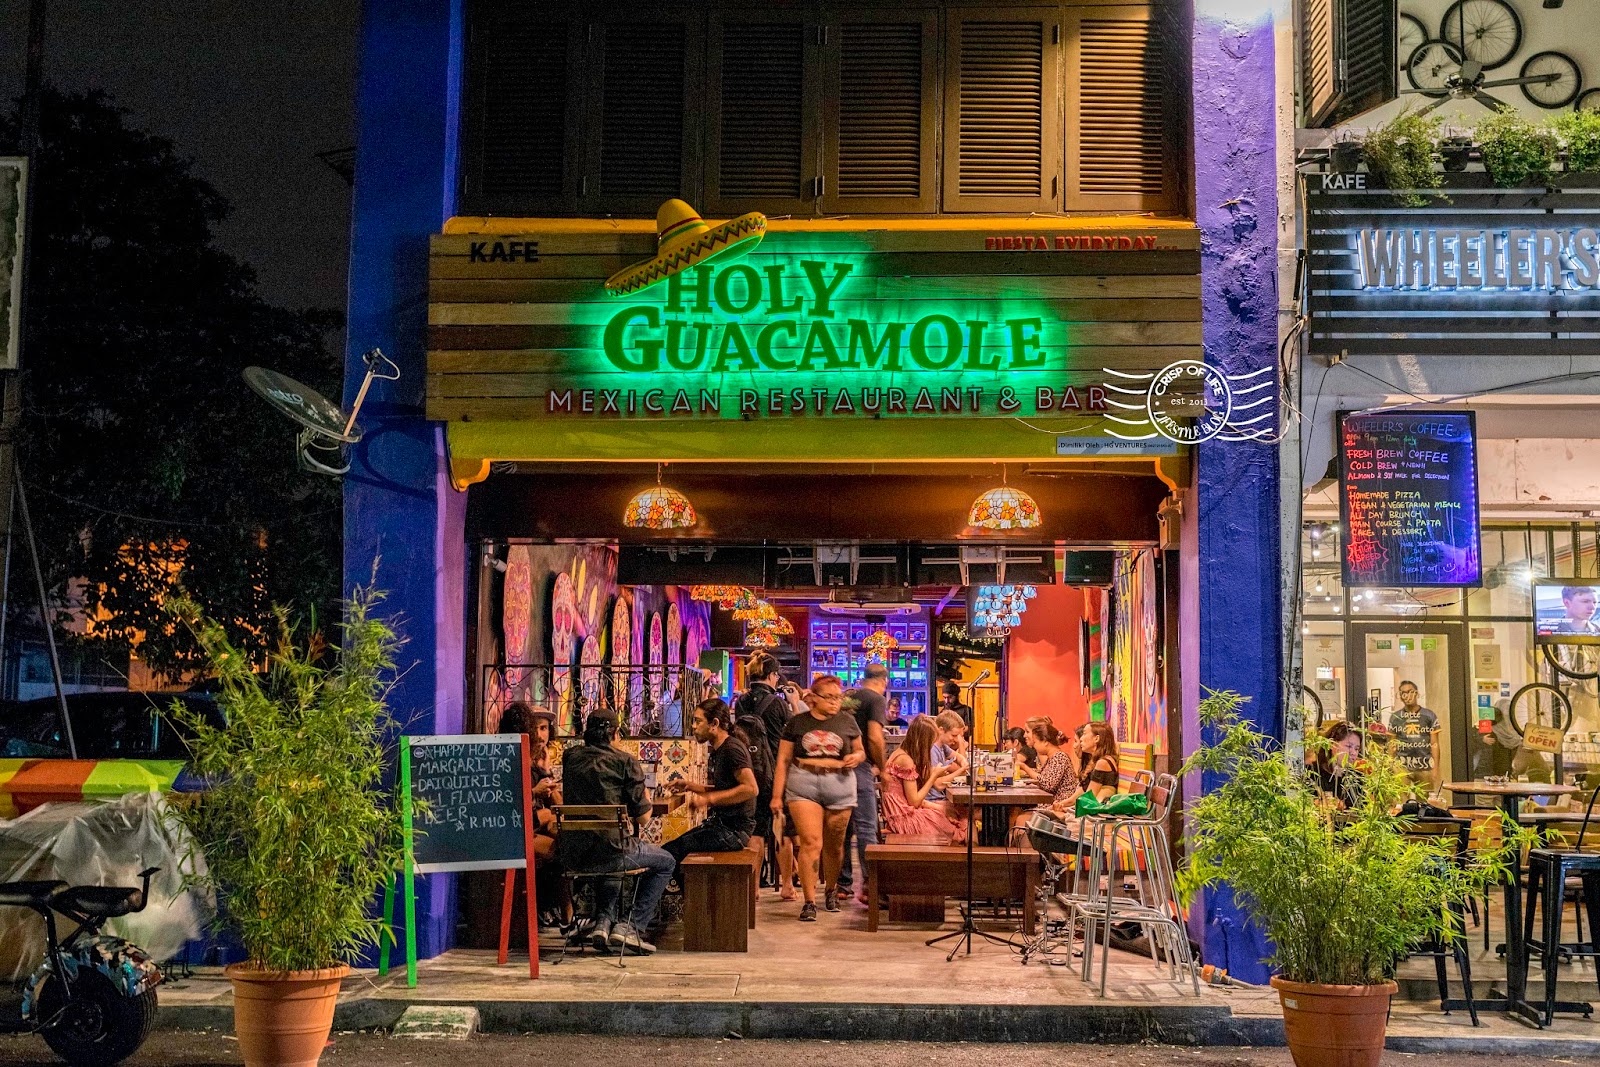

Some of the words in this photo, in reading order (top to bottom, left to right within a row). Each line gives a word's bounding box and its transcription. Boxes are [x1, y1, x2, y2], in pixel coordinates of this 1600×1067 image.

[1322, 174, 1366, 190] KAFE
[985, 236, 1048, 250] FIESTA
[470, 241, 539, 263] KAFE
[1358, 227, 1599, 288] WHEELER'S
[663, 259, 853, 318] HOLY
[603, 305, 1047, 373] GUACAMOLE
[548, 388, 721, 413] MEXICAN
[741, 387, 984, 413] RESTAURANT
[1000, 386, 1021, 410] &
[1036, 386, 1108, 412] BAR
[1347, 421, 1404, 433] WHEELER'S
[1409, 422, 1453, 437] COFFEE
[1346, 449, 1373, 459] FRESH
[1376, 448, 1404, 459] BREW
[1408, 450, 1449, 463] COFFEE
[1350, 460, 1374, 470] COLD
[1377, 461, 1398, 470] BREW
[1347, 472, 1375, 481] ALMOND
[1349, 491, 1389, 500] HOMEMADE
[1395, 491, 1421, 500] PIZZA
[1350, 502, 1377, 511] VEGAN
[1387, 501, 1430, 509] VEGETARIAN
[1434, 501, 1461, 509] MENU
[1389, 511, 1422, 519] BRUNCH
[1350, 520, 1371, 528] MAIN
[1416, 519, 1441, 527] PASTA
[1528, 735, 1557, 748] OPEN
[433, 745, 464, 758] HAPPY
[468, 744, 501, 756] HOUR
[418, 774, 500, 792] DAIQUIRIS
[451, 790, 514, 806] FLAVORS
